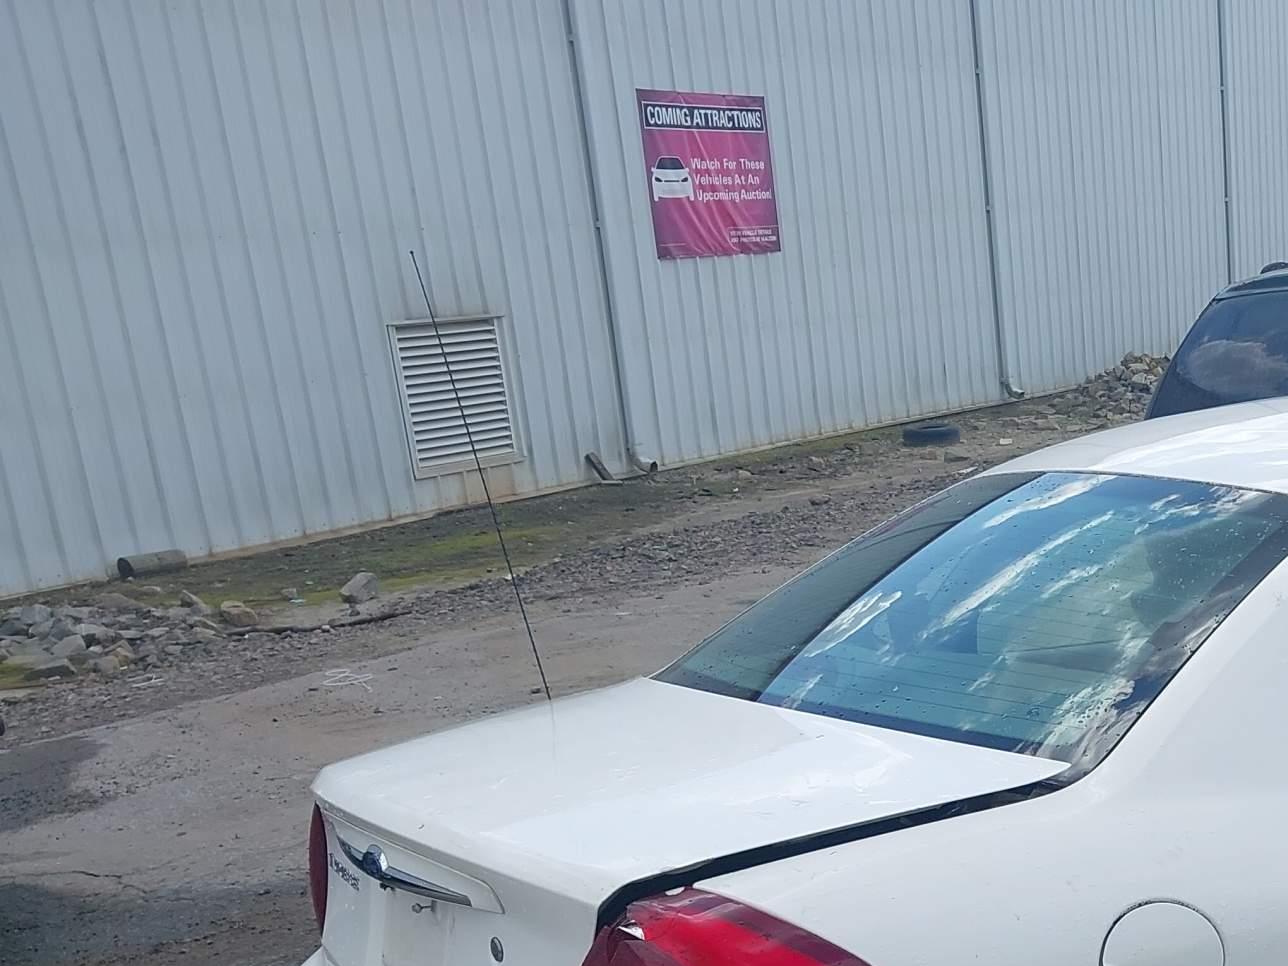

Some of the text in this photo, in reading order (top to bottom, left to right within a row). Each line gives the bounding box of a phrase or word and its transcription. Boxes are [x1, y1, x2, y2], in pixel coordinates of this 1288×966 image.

[646, 106, 762, 128] COMING ATTRACTIONS
[690, 158, 765, 170] Watch For These
[693, 173, 760, 185] Vehicles At An
[696, 188, 740, 203] Upcoming
